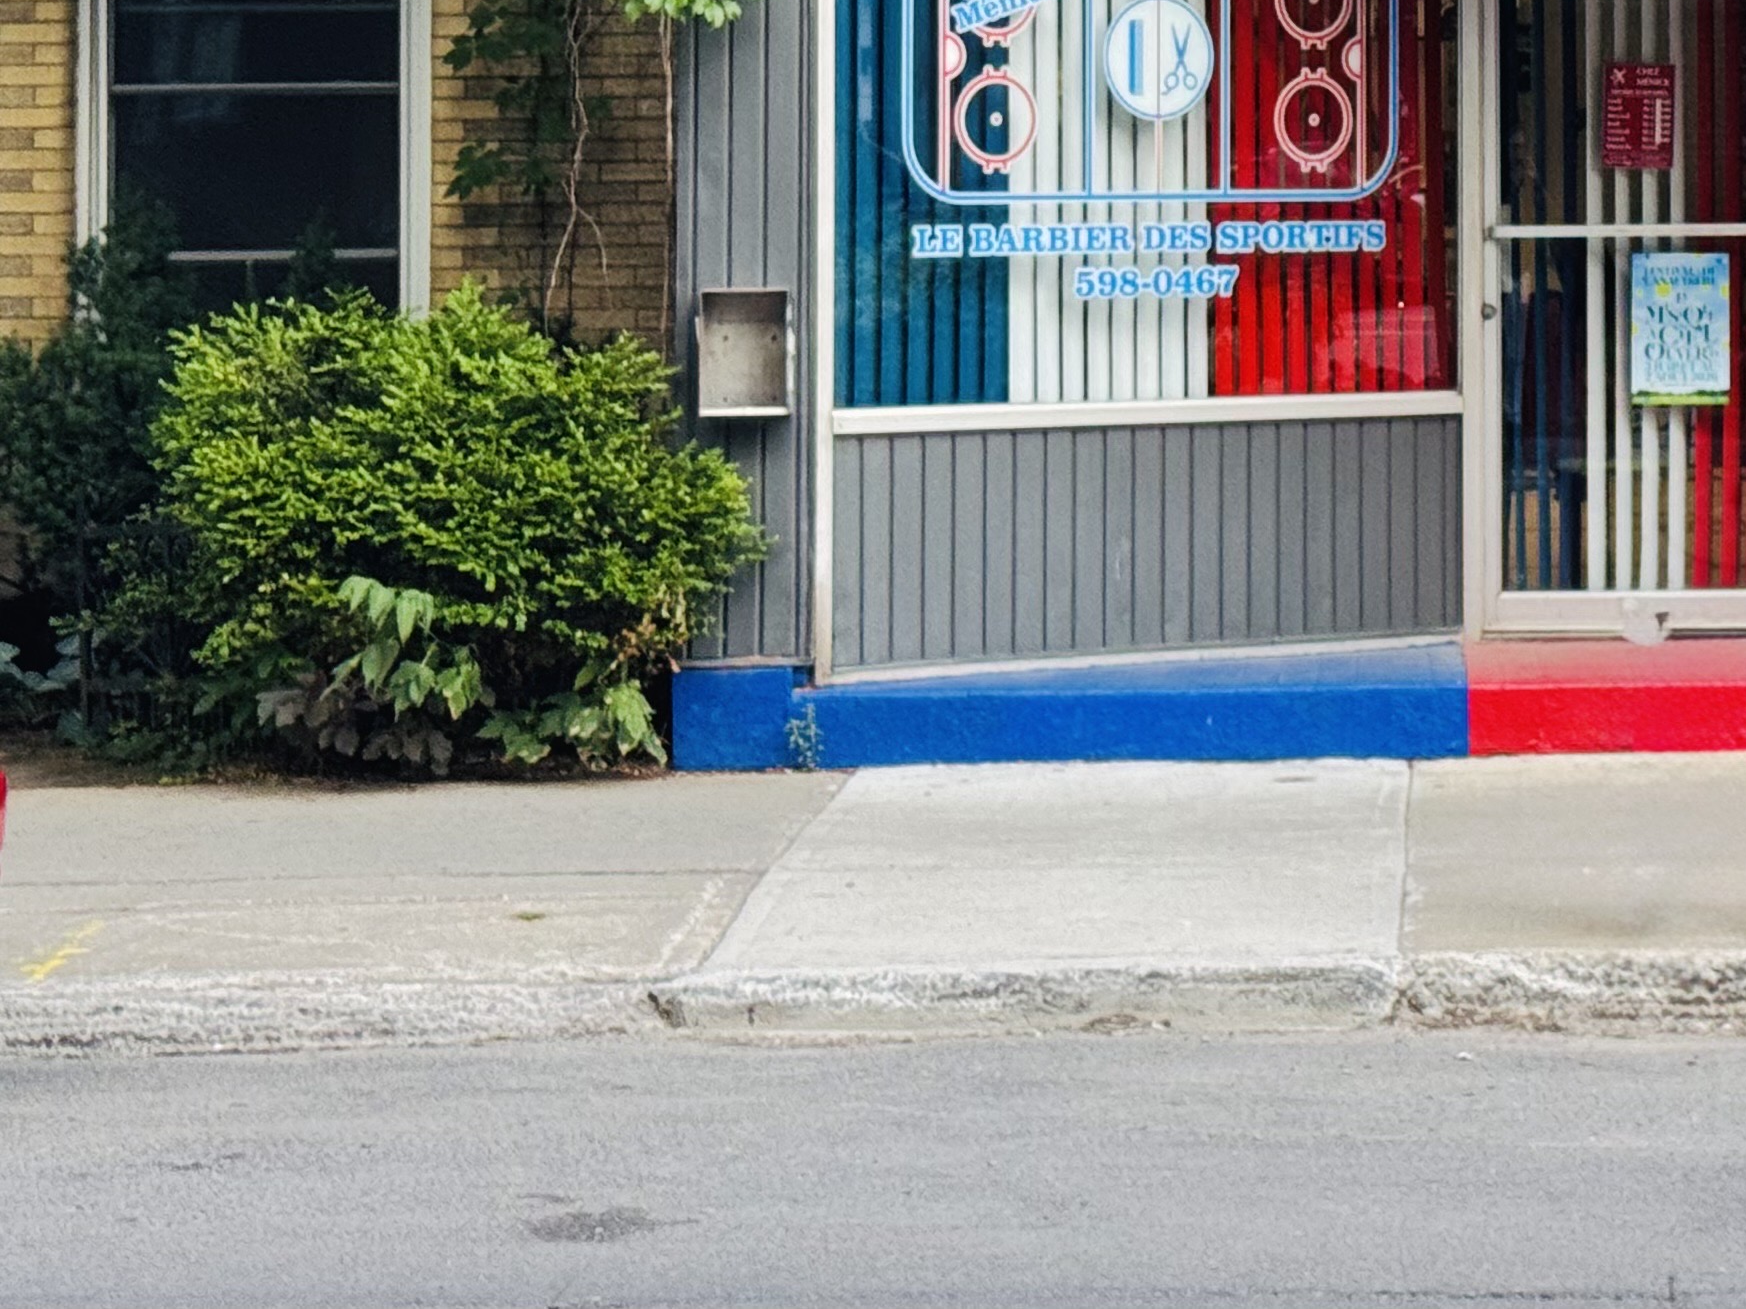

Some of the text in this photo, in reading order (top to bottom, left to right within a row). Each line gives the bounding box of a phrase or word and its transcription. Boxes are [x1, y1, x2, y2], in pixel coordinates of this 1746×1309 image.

[912, 221, 1387, 257] LE BARBIER DES SPORTIFS
[1075, 265, 1240, 299] 598-0467
